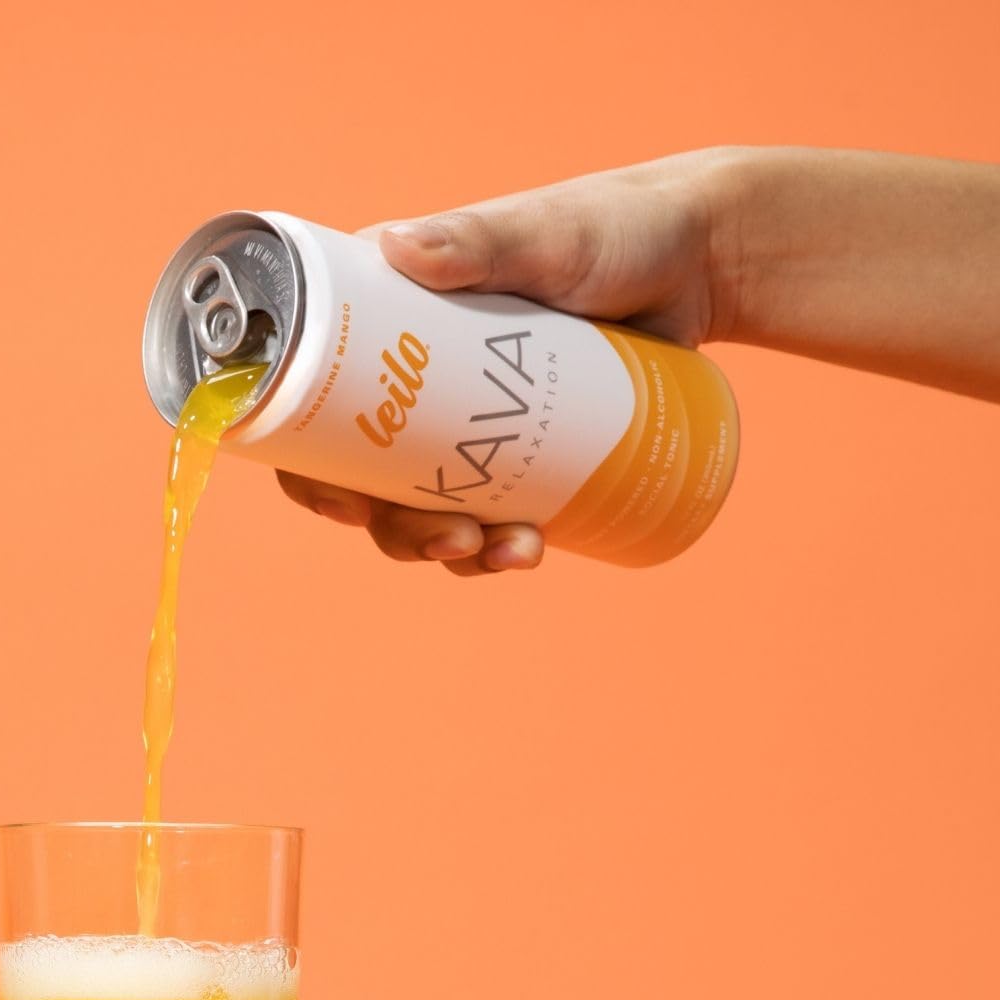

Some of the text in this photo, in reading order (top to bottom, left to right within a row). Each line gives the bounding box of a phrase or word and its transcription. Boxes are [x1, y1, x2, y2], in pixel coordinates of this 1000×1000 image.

[294, 303, 350, 432] TANGERINE MANGO
[355, 332, 429, 448] leilo
[413, 330, 535, 502] KAVA
[489, 351, 558, 502] RELAXATION
[663, 428, 680, 469] TONIC
